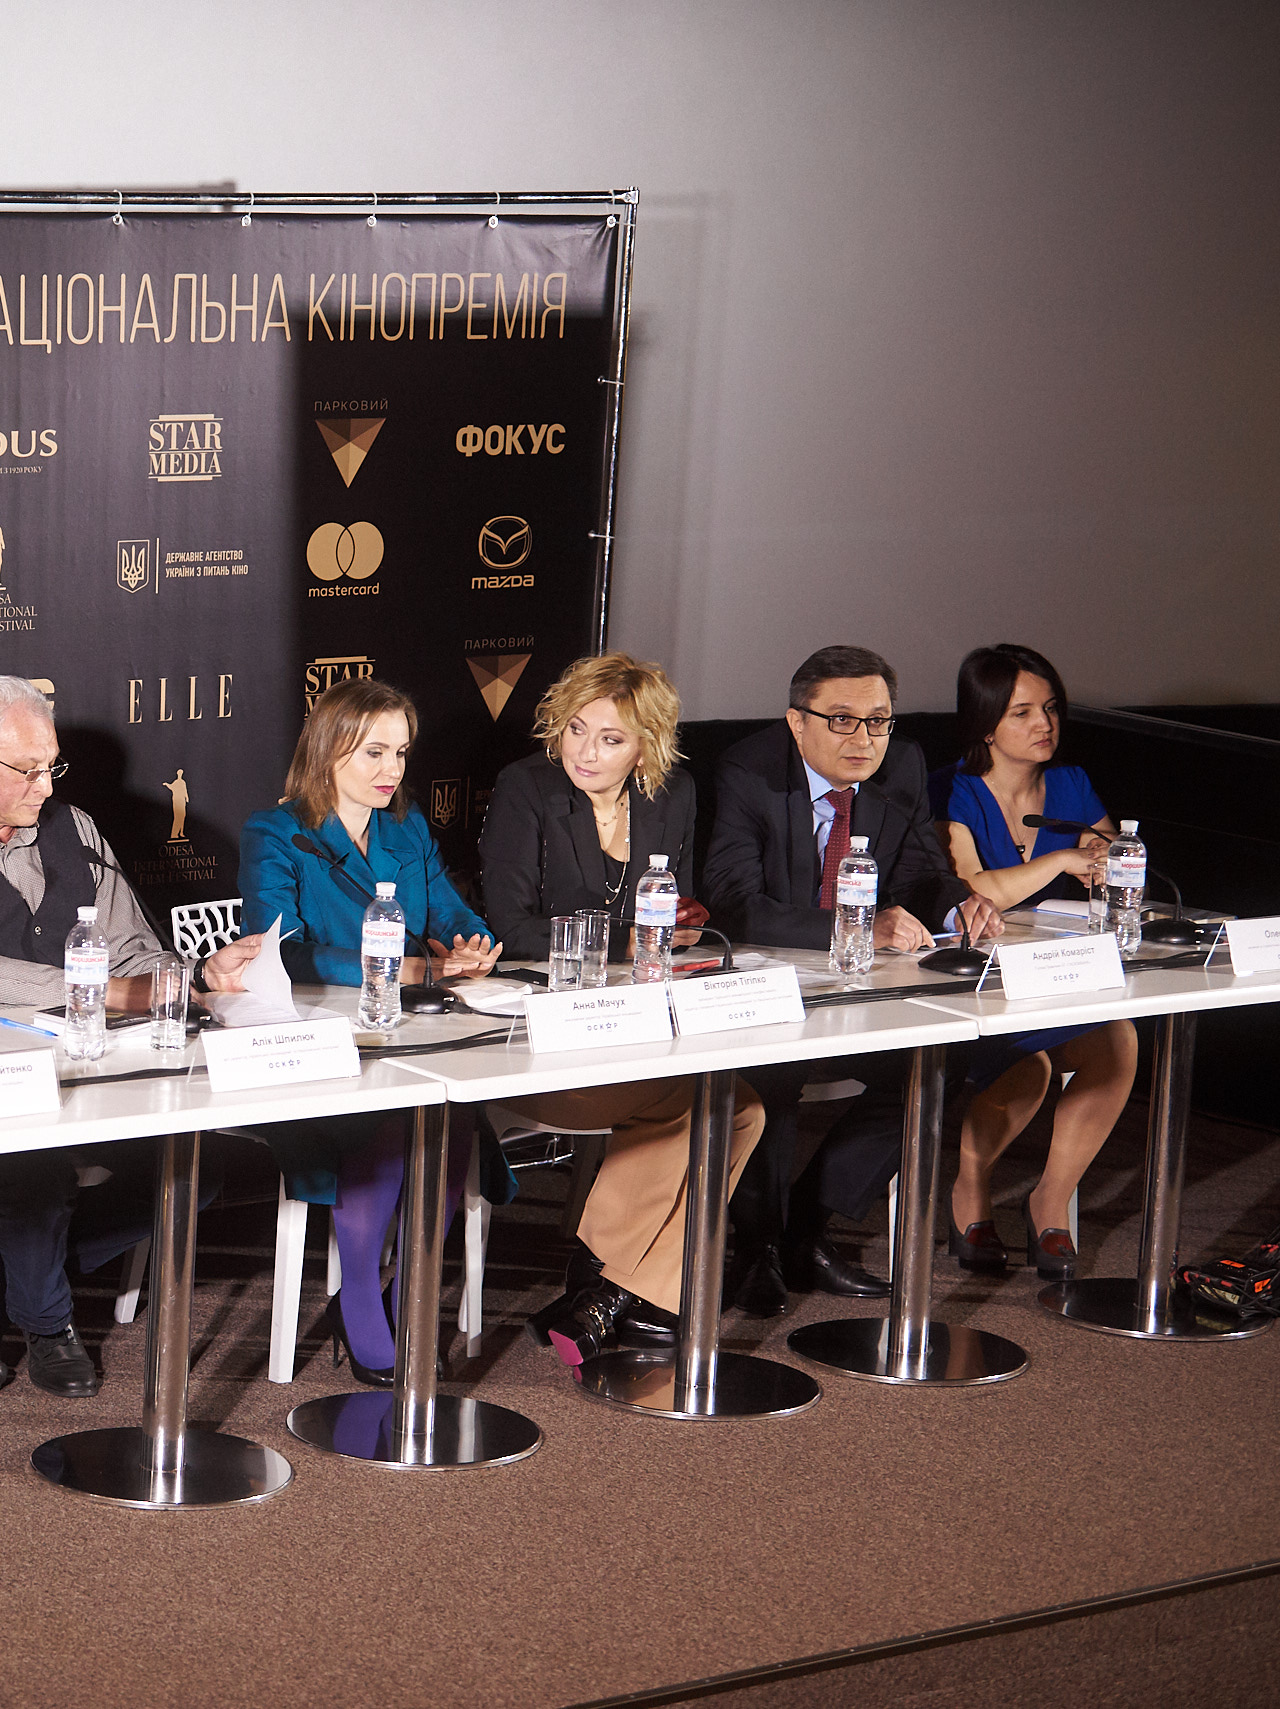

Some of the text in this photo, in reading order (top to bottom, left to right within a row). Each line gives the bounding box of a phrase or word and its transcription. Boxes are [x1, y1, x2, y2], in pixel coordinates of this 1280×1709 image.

[307, 271, 568, 342] КІНОПРЕМІЯ
[315, 399, 387, 411] ПАРКОВИЙ
[149, 422, 222, 450] STAR
[456, 424, 565, 457] ФОКУС
[149, 450, 222, 475] MEDIA
[165, 550, 243, 564] ДЕРЖАВНЕ АГЕНТСТВО
[165, 565, 195, 578] УКРАЇНИ
[203, 566, 230, 576] ПИТАНЬ
[231, 564, 249, 575] КІНО
[472, 575, 534, 589] mazda
[309, 583, 379, 597] mastercard
[465, 637, 534, 649] ПАРКОВИЙ
[129, 675, 232, 723] ELLE
[160, 845, 194, 857] ODESA
[1032, 951, 1060, 962] Андрій
[704, 979, 738, 991] Вікторія
[573, 998, 626, 1011] Анна Мачух
[252, 1032, 315, 1047] Алік Шпилюк
